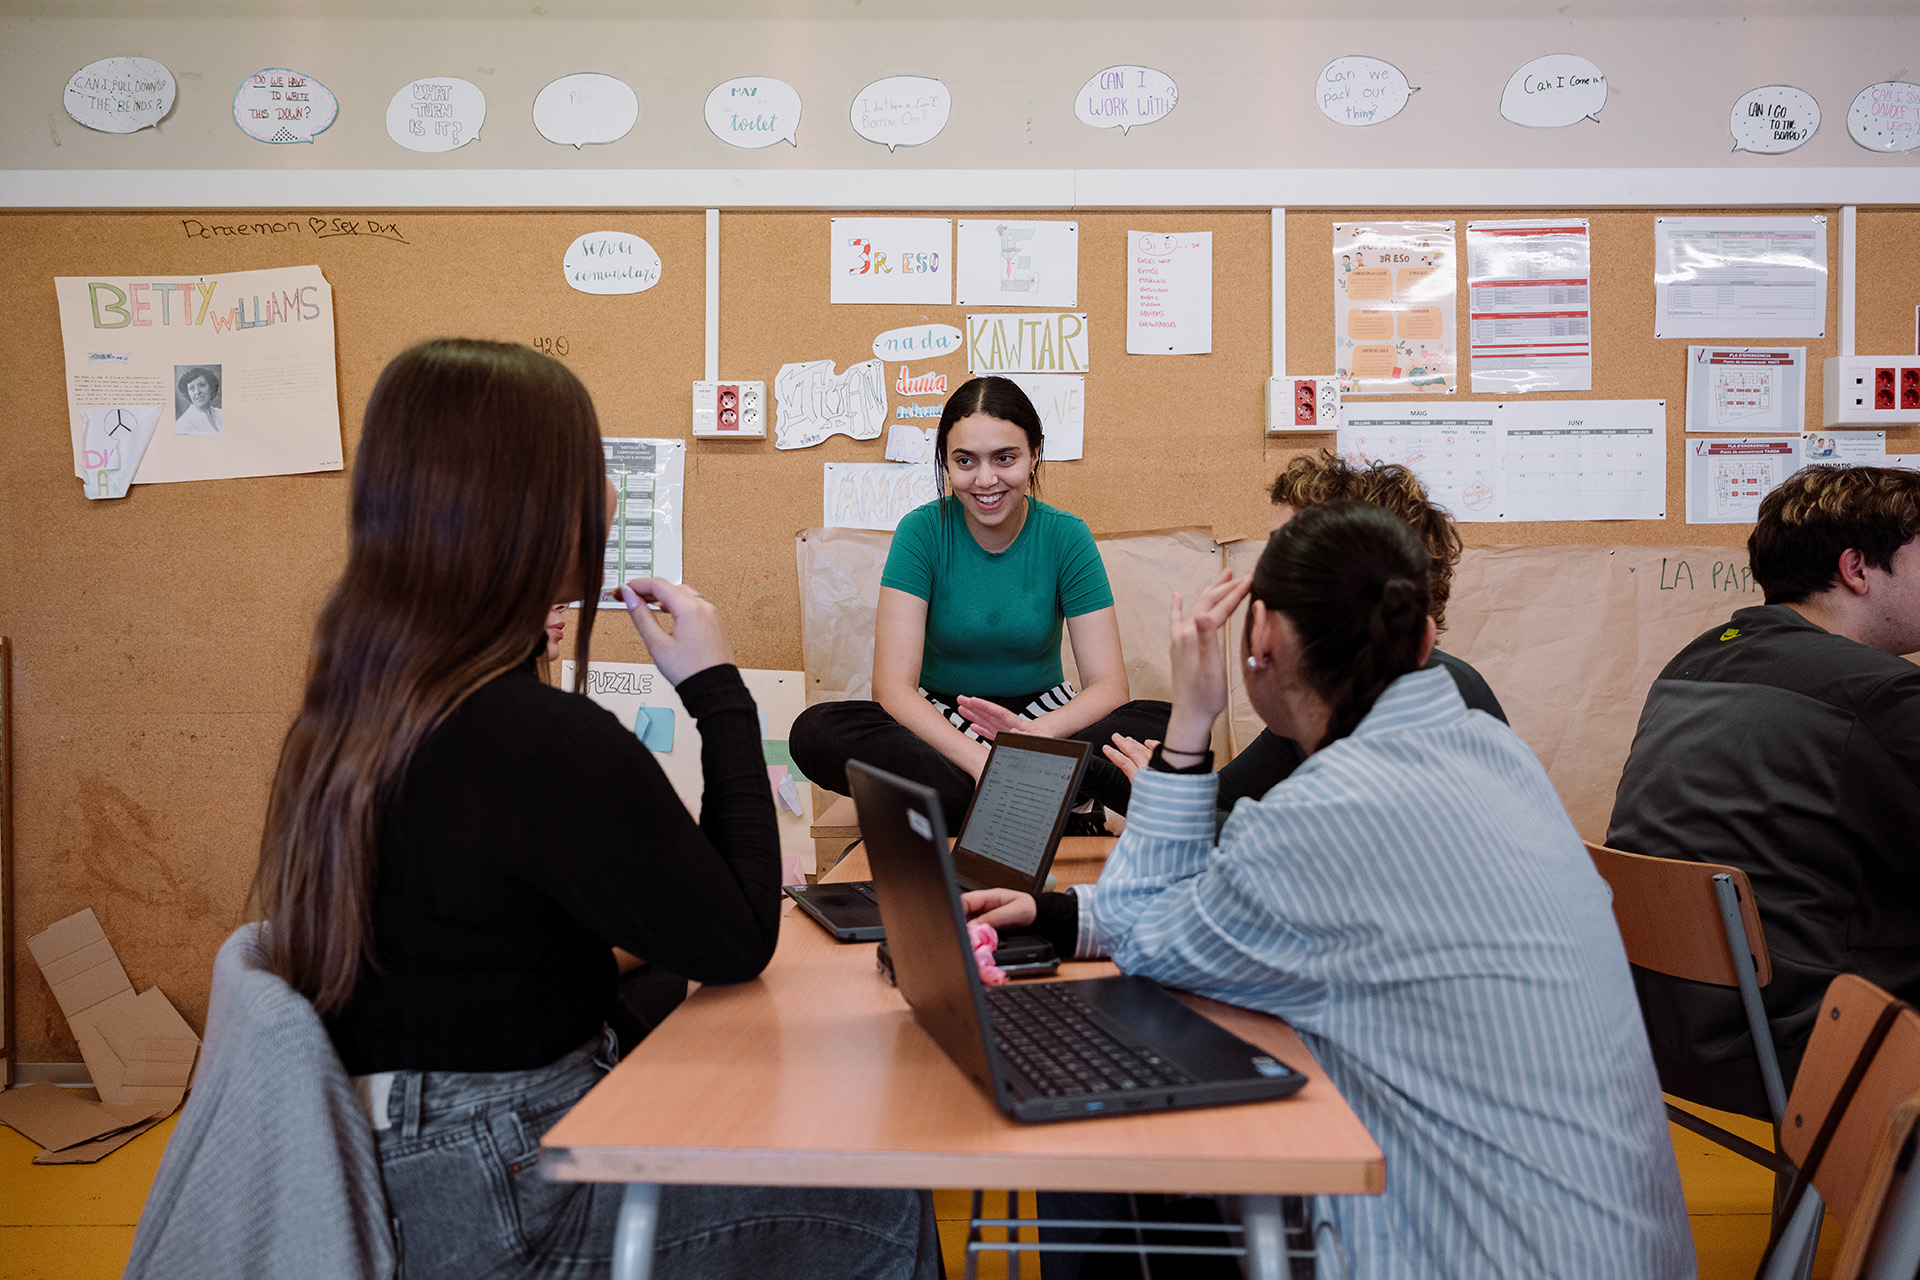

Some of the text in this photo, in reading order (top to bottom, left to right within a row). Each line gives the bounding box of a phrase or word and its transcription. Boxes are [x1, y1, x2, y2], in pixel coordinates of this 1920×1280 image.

[253, 75, 307, 87] DO WE HAVE
[1101, 70, 1146, 90] CAN I
[1325, 65, 1390, 82] Can we
[74, 77, 99, 90] CAN
[101, 79, 107, 90] I
[112, 80, 132, 93] PULL
[413, 83, 453, 101] WHAT
[731, 87, 758, 97] MAY
[1523, 74, 1552, 94] Can
[1556, 76, 1565, 88] I
[87, 96, 112, 112] THE
[1323, 84, 1386, 109] pack our
[1871, 88, 1893, 100] CAN
[1895, 91, 1902, 102] I
[248, 109, 269, 119] THIS
[411, 103, 453, 118] TURN
[860, 99, 870, 113] I
[1089, 97, 1128, 116] WORK
[1748, 101, 1788, 119] CAN I GO
[409, 119, 426, 136] IS
[730, 113, 779, 132] toilet
[1769, 119, 1781, 130] TO
[331, 217, 360, 236] Sex
[902, 251, 940, 274] ESO
[1379, 254, 1410, 263] 3R ESO
[88, 281, 218, 330] BETTY
[884, 330, 951, 352] nada
[970, 313, 1083, 371] KAWTAR
[896, 367, 946, 394] dunia
[1660, 557, 1694, 590] LA
[587, 670, 654, 696] PUZZLE
